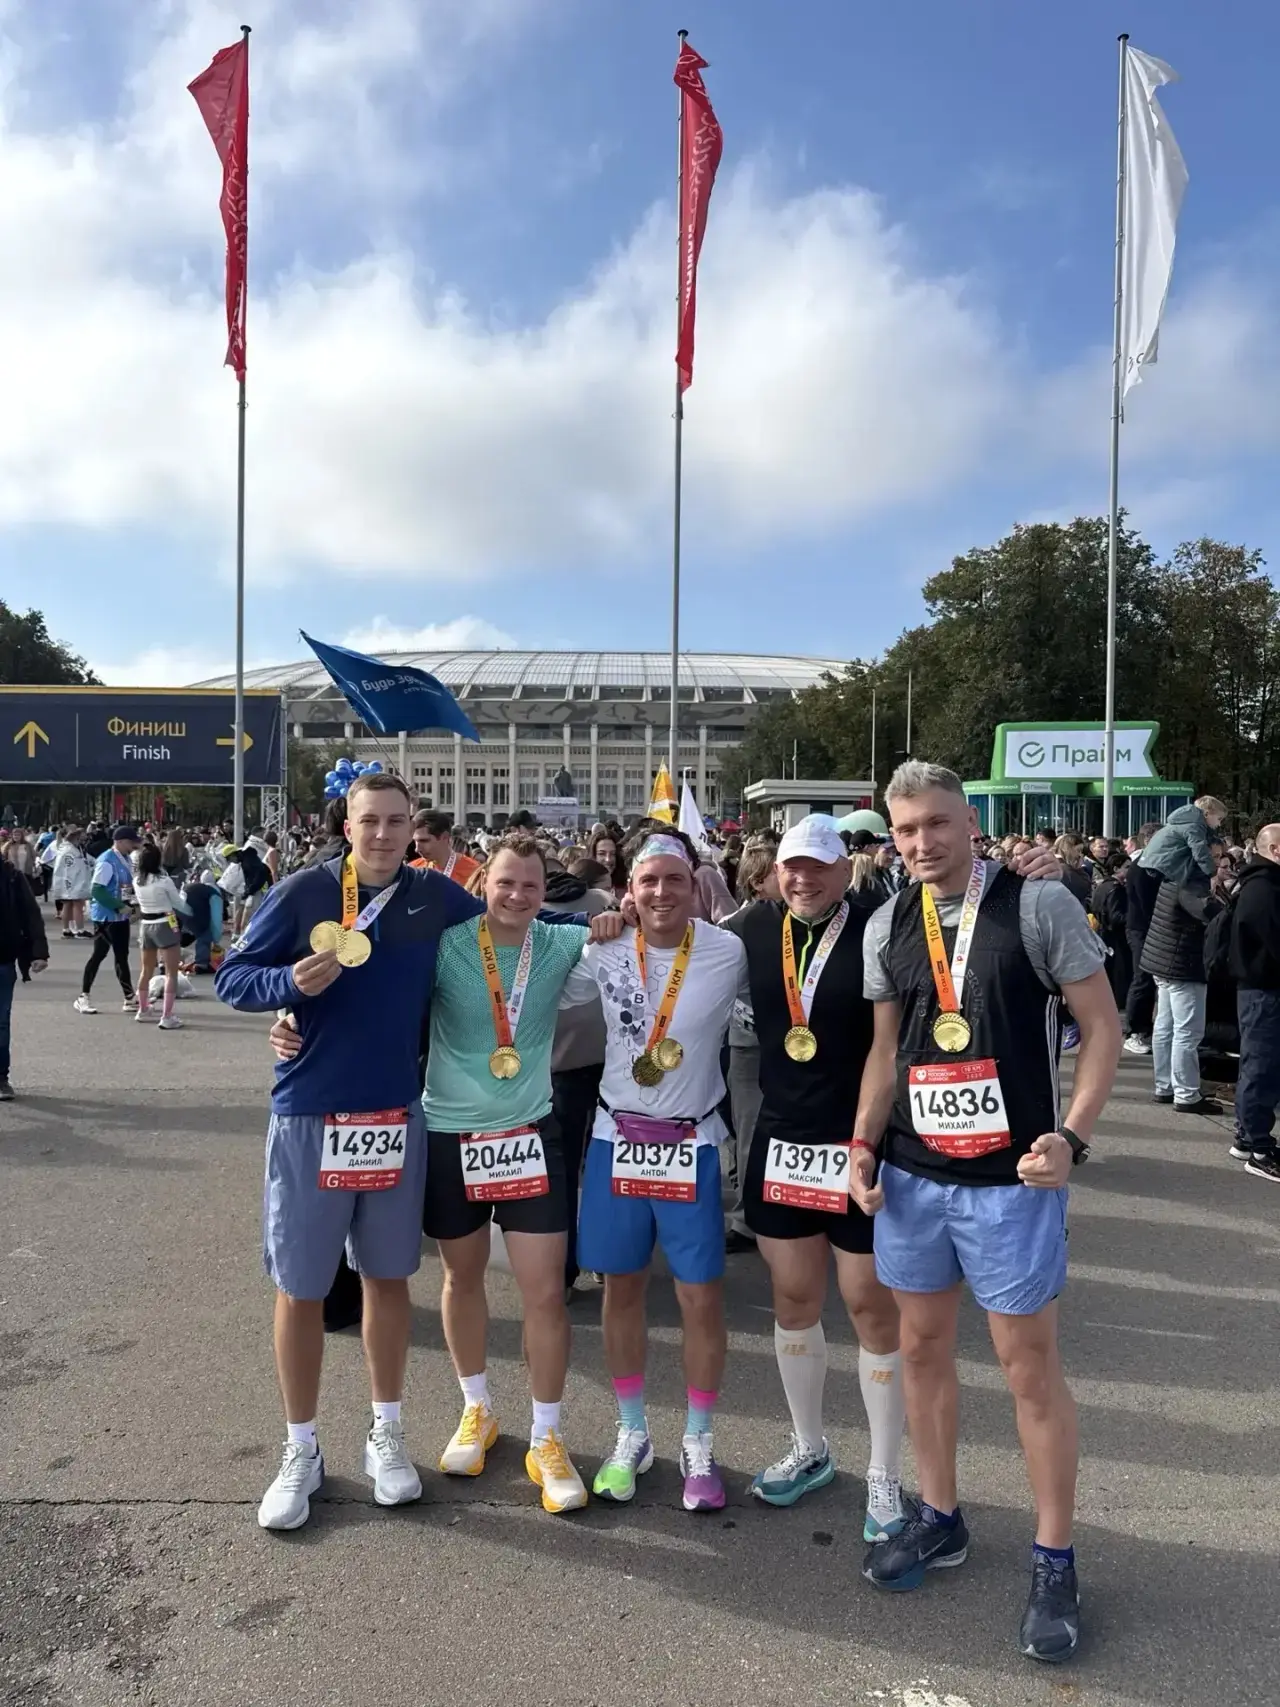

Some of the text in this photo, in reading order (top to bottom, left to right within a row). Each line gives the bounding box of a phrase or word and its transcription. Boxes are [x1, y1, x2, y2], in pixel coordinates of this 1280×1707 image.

[107, 716, 186, 737] Финиш
[122, 744, 171, 760] Finish
[347, 904, 356, 914] 10
[930, 930, 940, 942] 10
[785, 949, 793, 960] 10
[489, 963, 497, 975] 10
[667, 987, 677, 998] 10
[914, 1085, 1000, 1118] 14836
[937, 1120, 976, 1130] МИХАИЛ
[329, 1129, 404, 1156] 14934
[464, 1138, 541, 1172] 20444
[616, 1141, 693, 1168] 20375
[773, 1143, 848, 1176] 13919
[348, 1158, 383, 1167] ДАНИИЛ
[488, 1167, 522, 1179] МИХАИЛ
[640, 1169, 667, 1177] АНТОН
[788, 1173, 823, 1184] МАКСИМ
[326, 1173, 339, 1188] G
[473, 1186, 484, 1199] E
[620, 1181, 630, 1195] E
[770, 1185, 781, 1201] G
